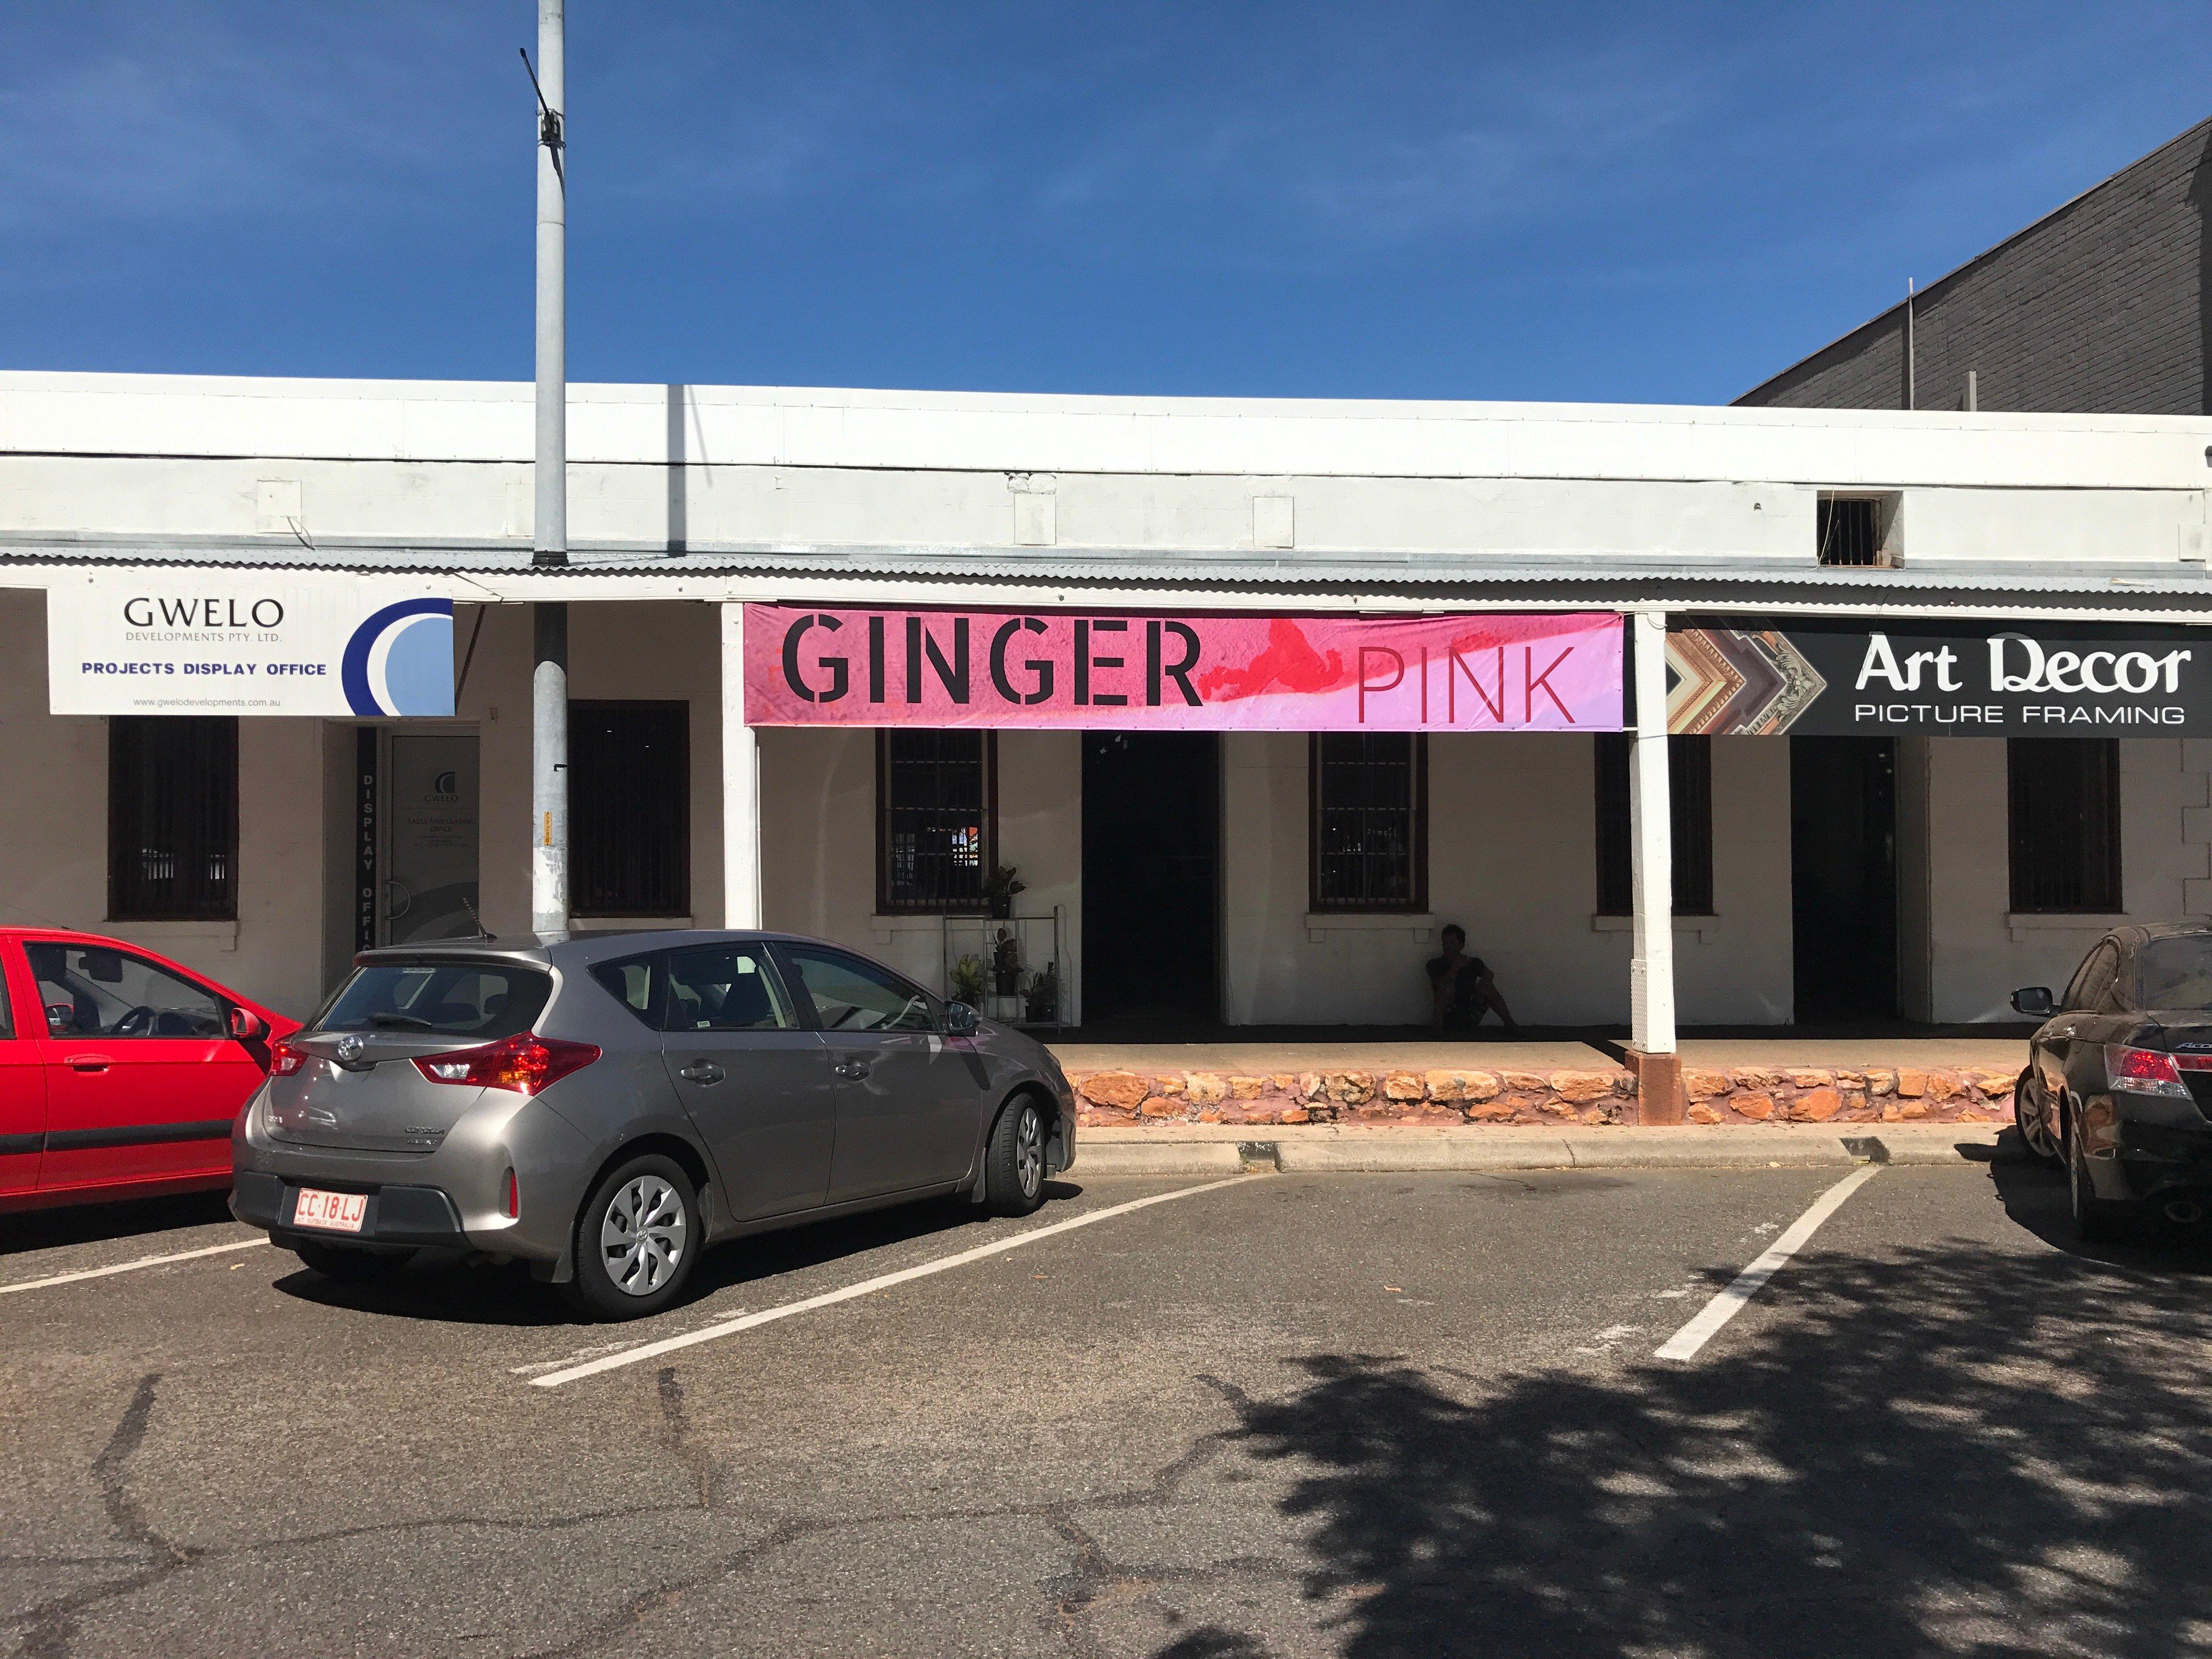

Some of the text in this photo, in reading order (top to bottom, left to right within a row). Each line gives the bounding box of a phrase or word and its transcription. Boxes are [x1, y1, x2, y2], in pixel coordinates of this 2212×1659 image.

[124, 597, 284, 628] GWELO
[126, 632, 282, 642] DEVELOPMENTS PTY. LTD.
[82, 662, 326, 675] PROJECTS DISPLAY OFFICE
[782, 614, 1576, 724] GINGER PINK
[1854, 631, 2192, 693] Art Decor
[133, 698, 281, 708] www.gwelodevelopments.com.au
[1855, 704, 2185, 724] PICTURE FRAMING
[363, 775, 373, 870] DISPLAY
